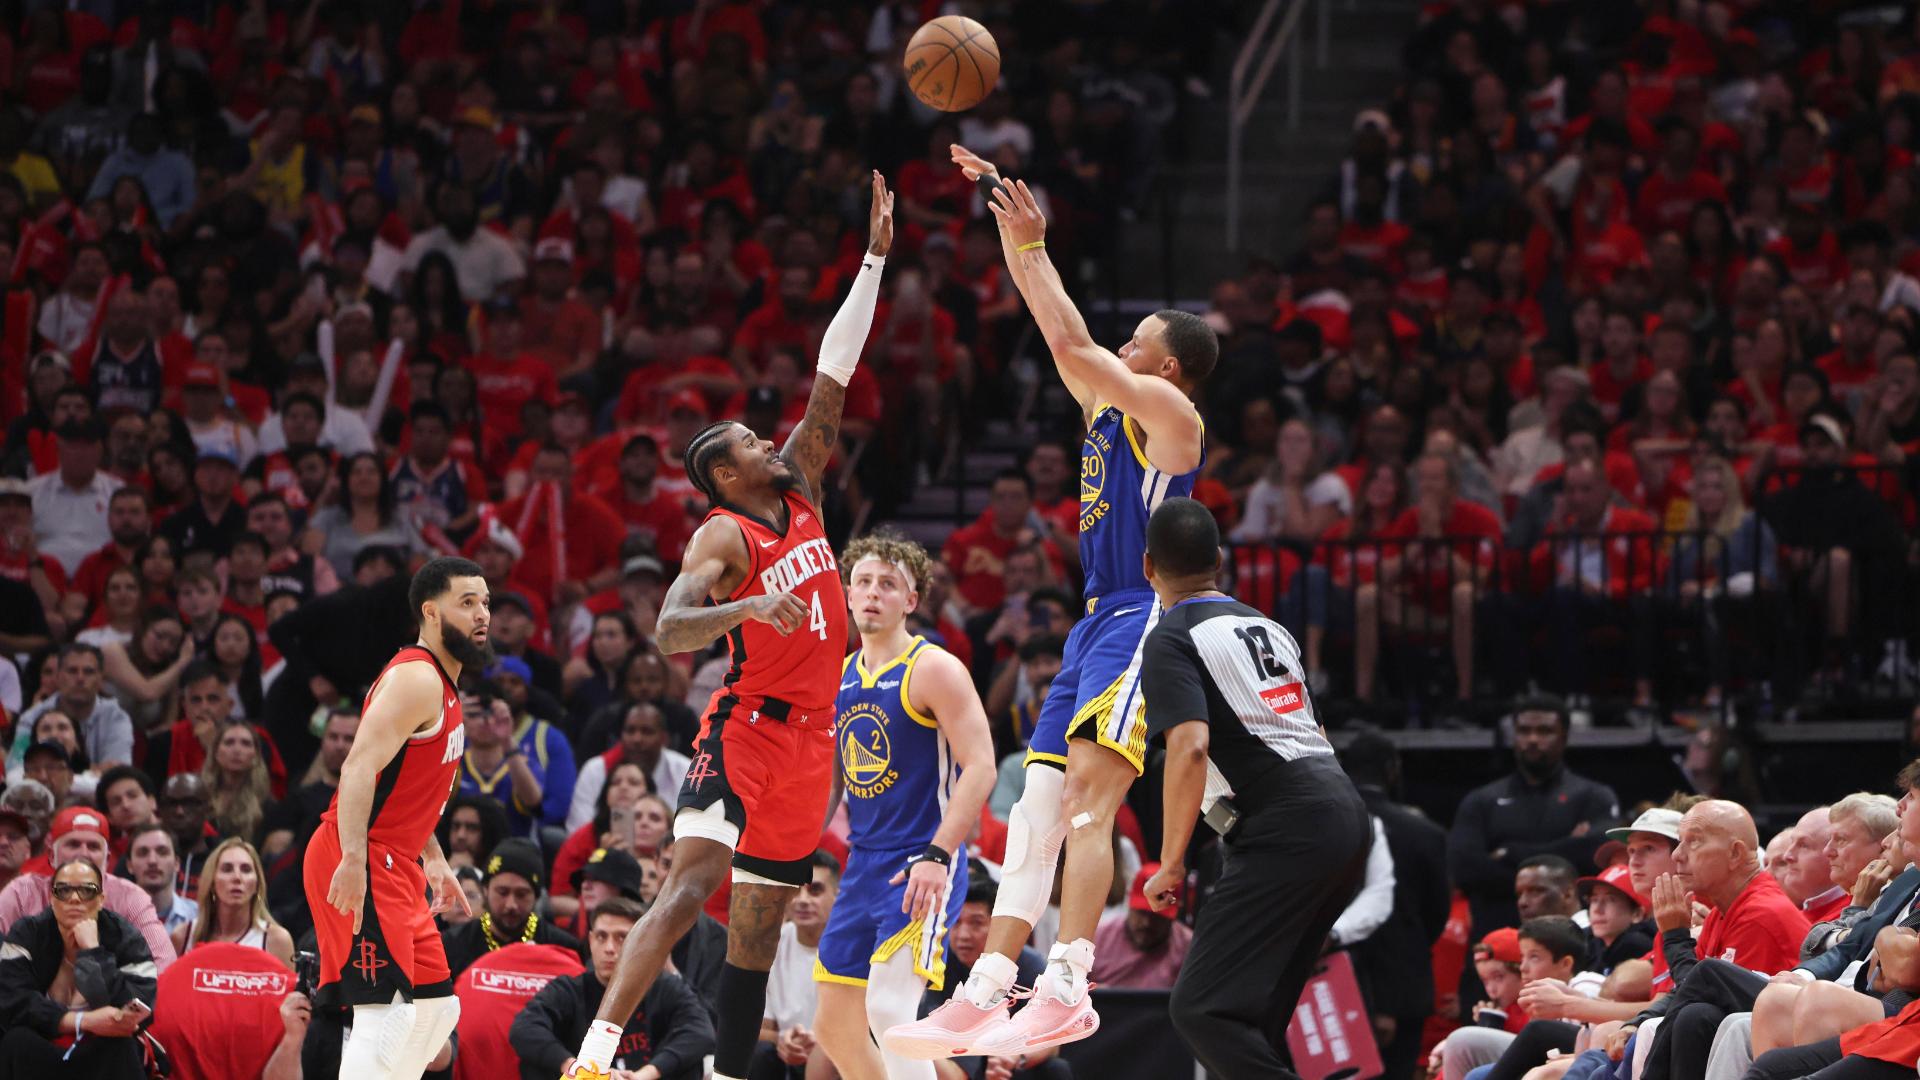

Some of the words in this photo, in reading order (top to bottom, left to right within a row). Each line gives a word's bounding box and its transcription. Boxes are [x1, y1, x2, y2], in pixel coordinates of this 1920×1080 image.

[1081, 456, 1099, 478] 30
[760, 537, 836, 596] ROCKETS
[810, 590, 827, 640] 4
[1264, 691, 1299, 710] Emirates
[837, 703, 870, 728] GOLDEN
[870, 704, 891, 727] STATE
[871, 730, 882, 751] 2
[842, 769, 900, 800] WARRIORS
